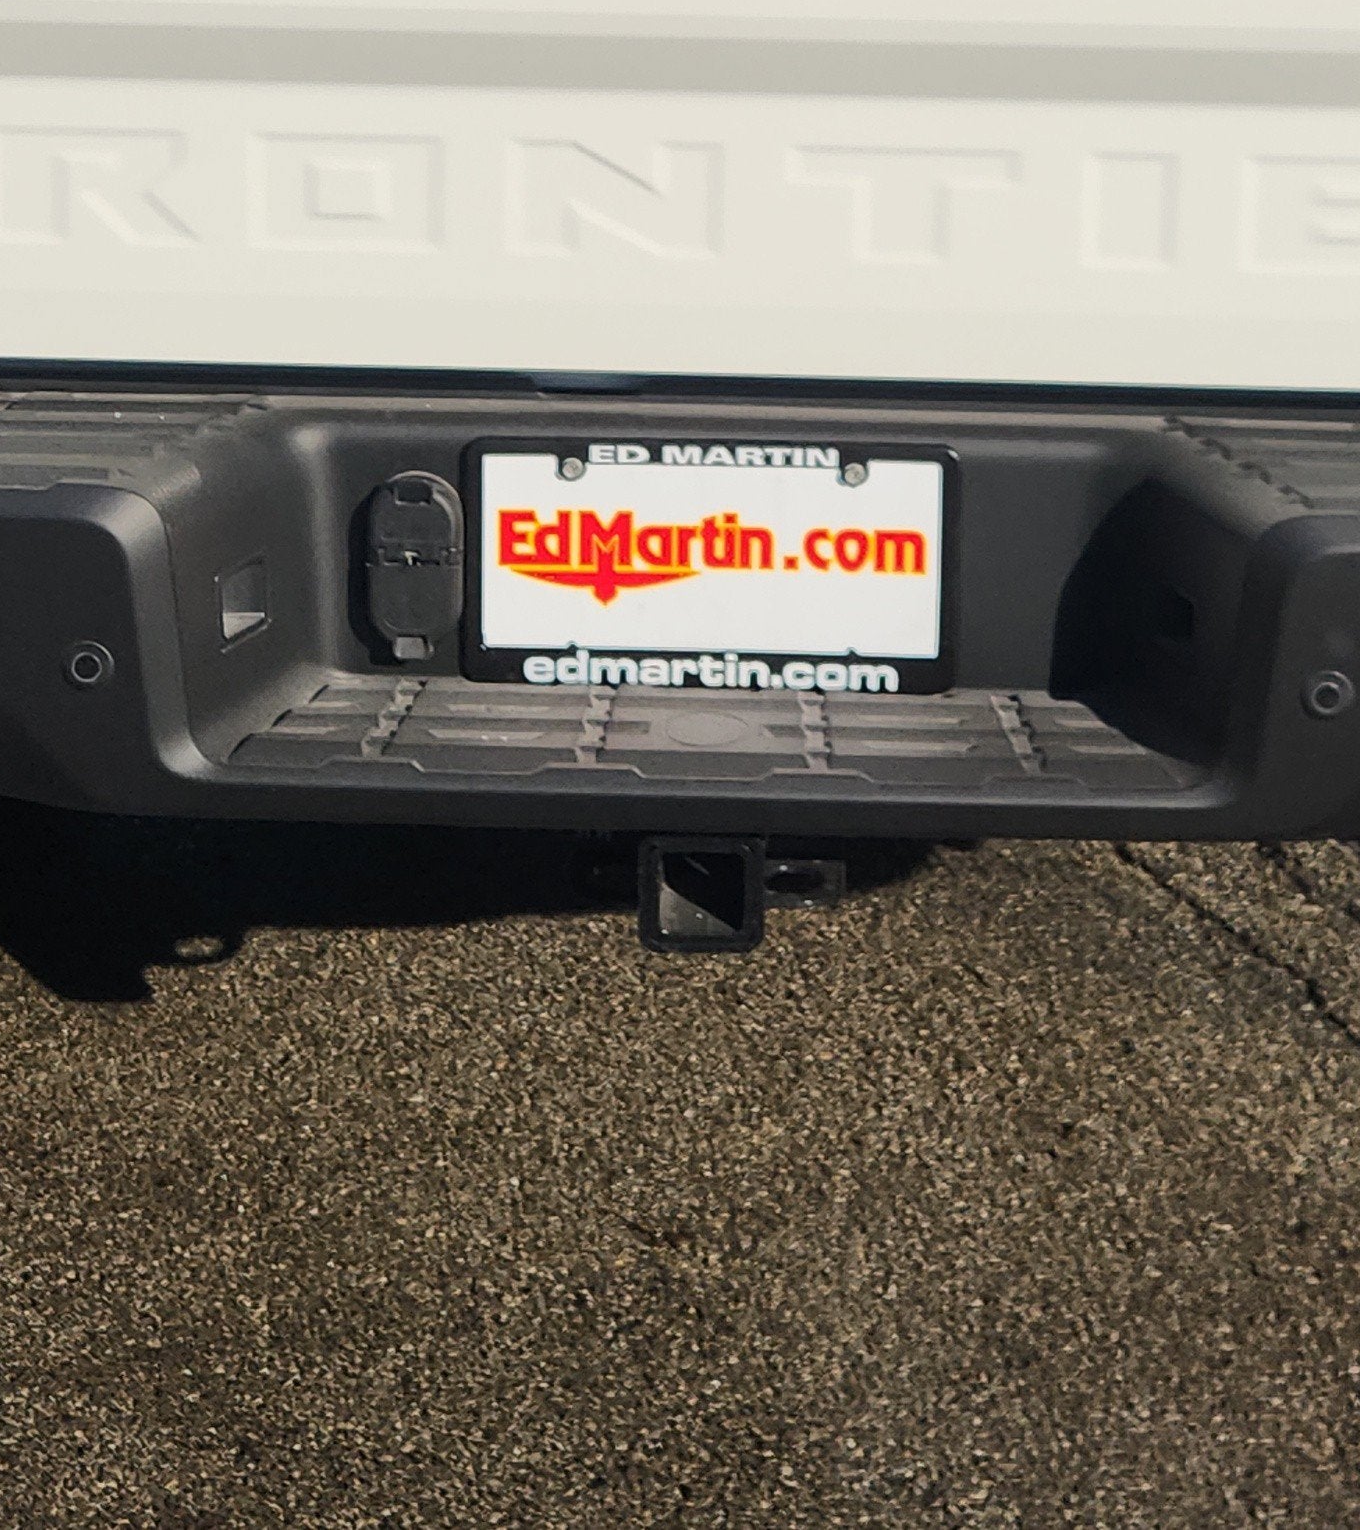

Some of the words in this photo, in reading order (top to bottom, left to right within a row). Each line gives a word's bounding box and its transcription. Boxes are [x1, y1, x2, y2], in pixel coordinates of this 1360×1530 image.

[588, 443, 650, 465] ED
[661, 445, 840, 469] MARTIN
[497, 509, 927, 576] EdMartin.com
[522, 650, 900, 693] edmartin.com
